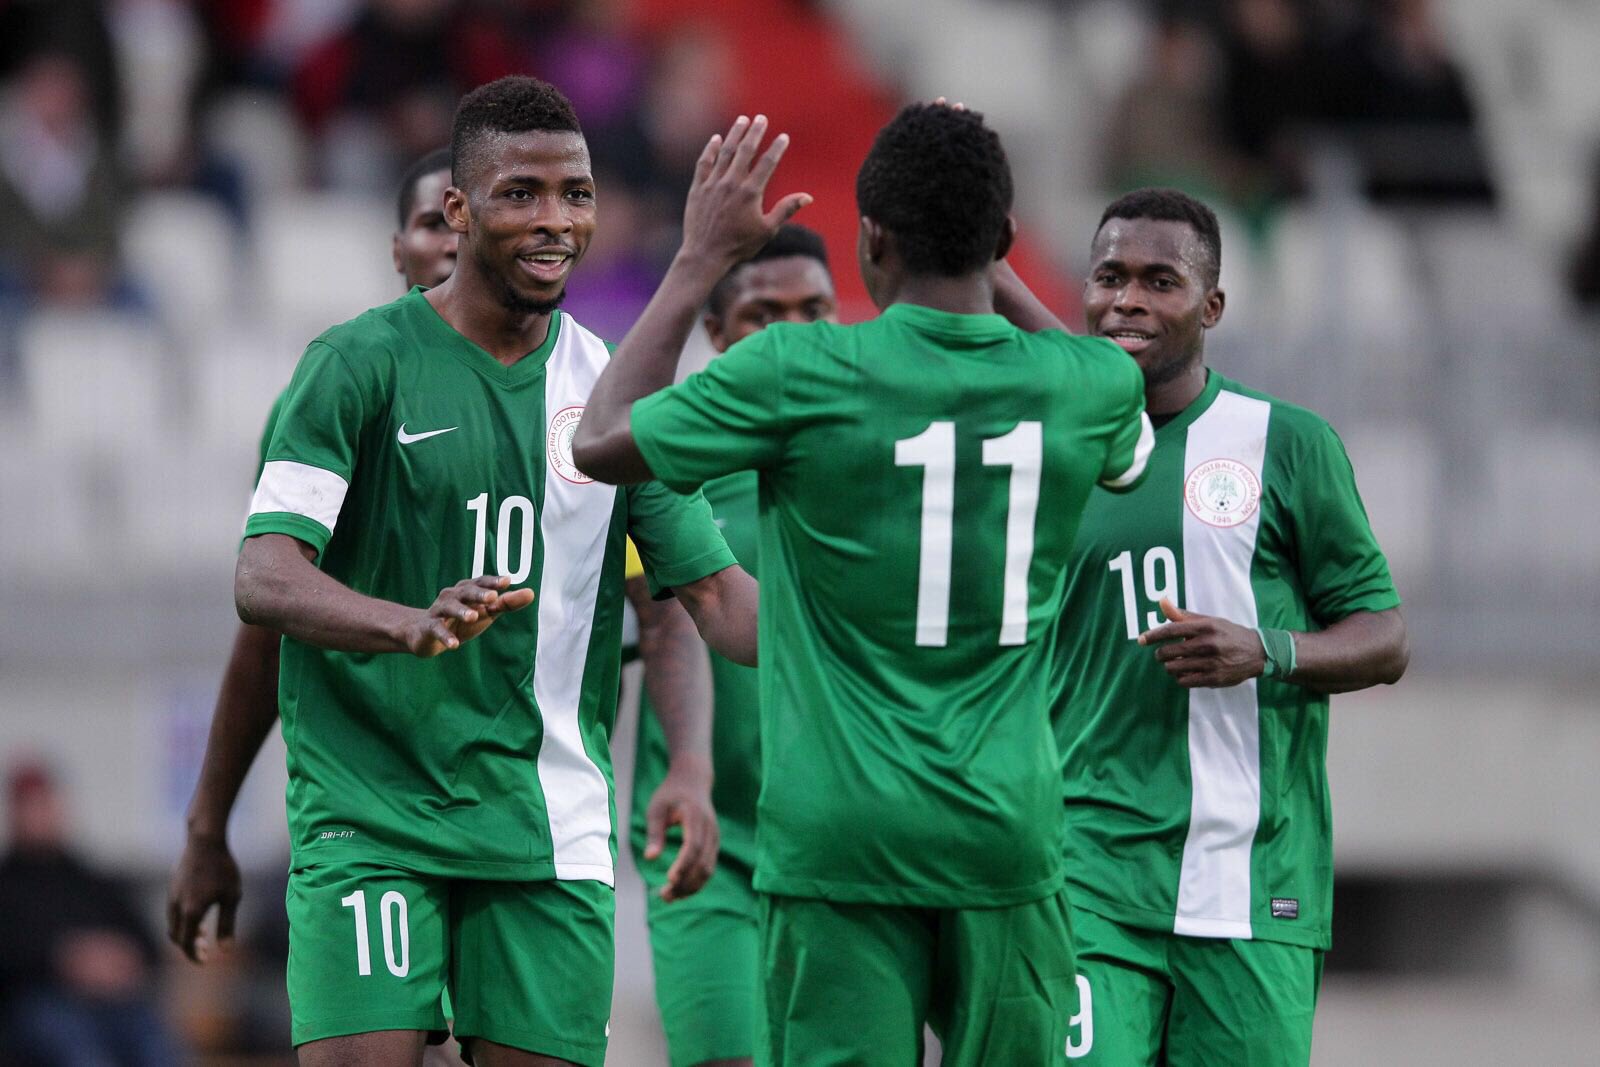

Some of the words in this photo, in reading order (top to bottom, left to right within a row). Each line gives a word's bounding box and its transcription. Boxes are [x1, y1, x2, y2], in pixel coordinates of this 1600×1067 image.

[550, 432, 563, 468] NIGERIA
[553, 411, 583, 432] FOOTBA
[573, 471, 590, 480] 194
[1194, 462, 1236, 480] FOOTBALL
[1239, 467, 1257, 517] FEDERATION
[466, 492, 535, 585] 10
[894, 421, 1043, 646] 11
[1108, 546, 1179, 640] 19
[321, 831, 355, 839] DRI-FIT
[341, 890, 410, 978] 10
[1065, 974, 1094, 1058] 9
